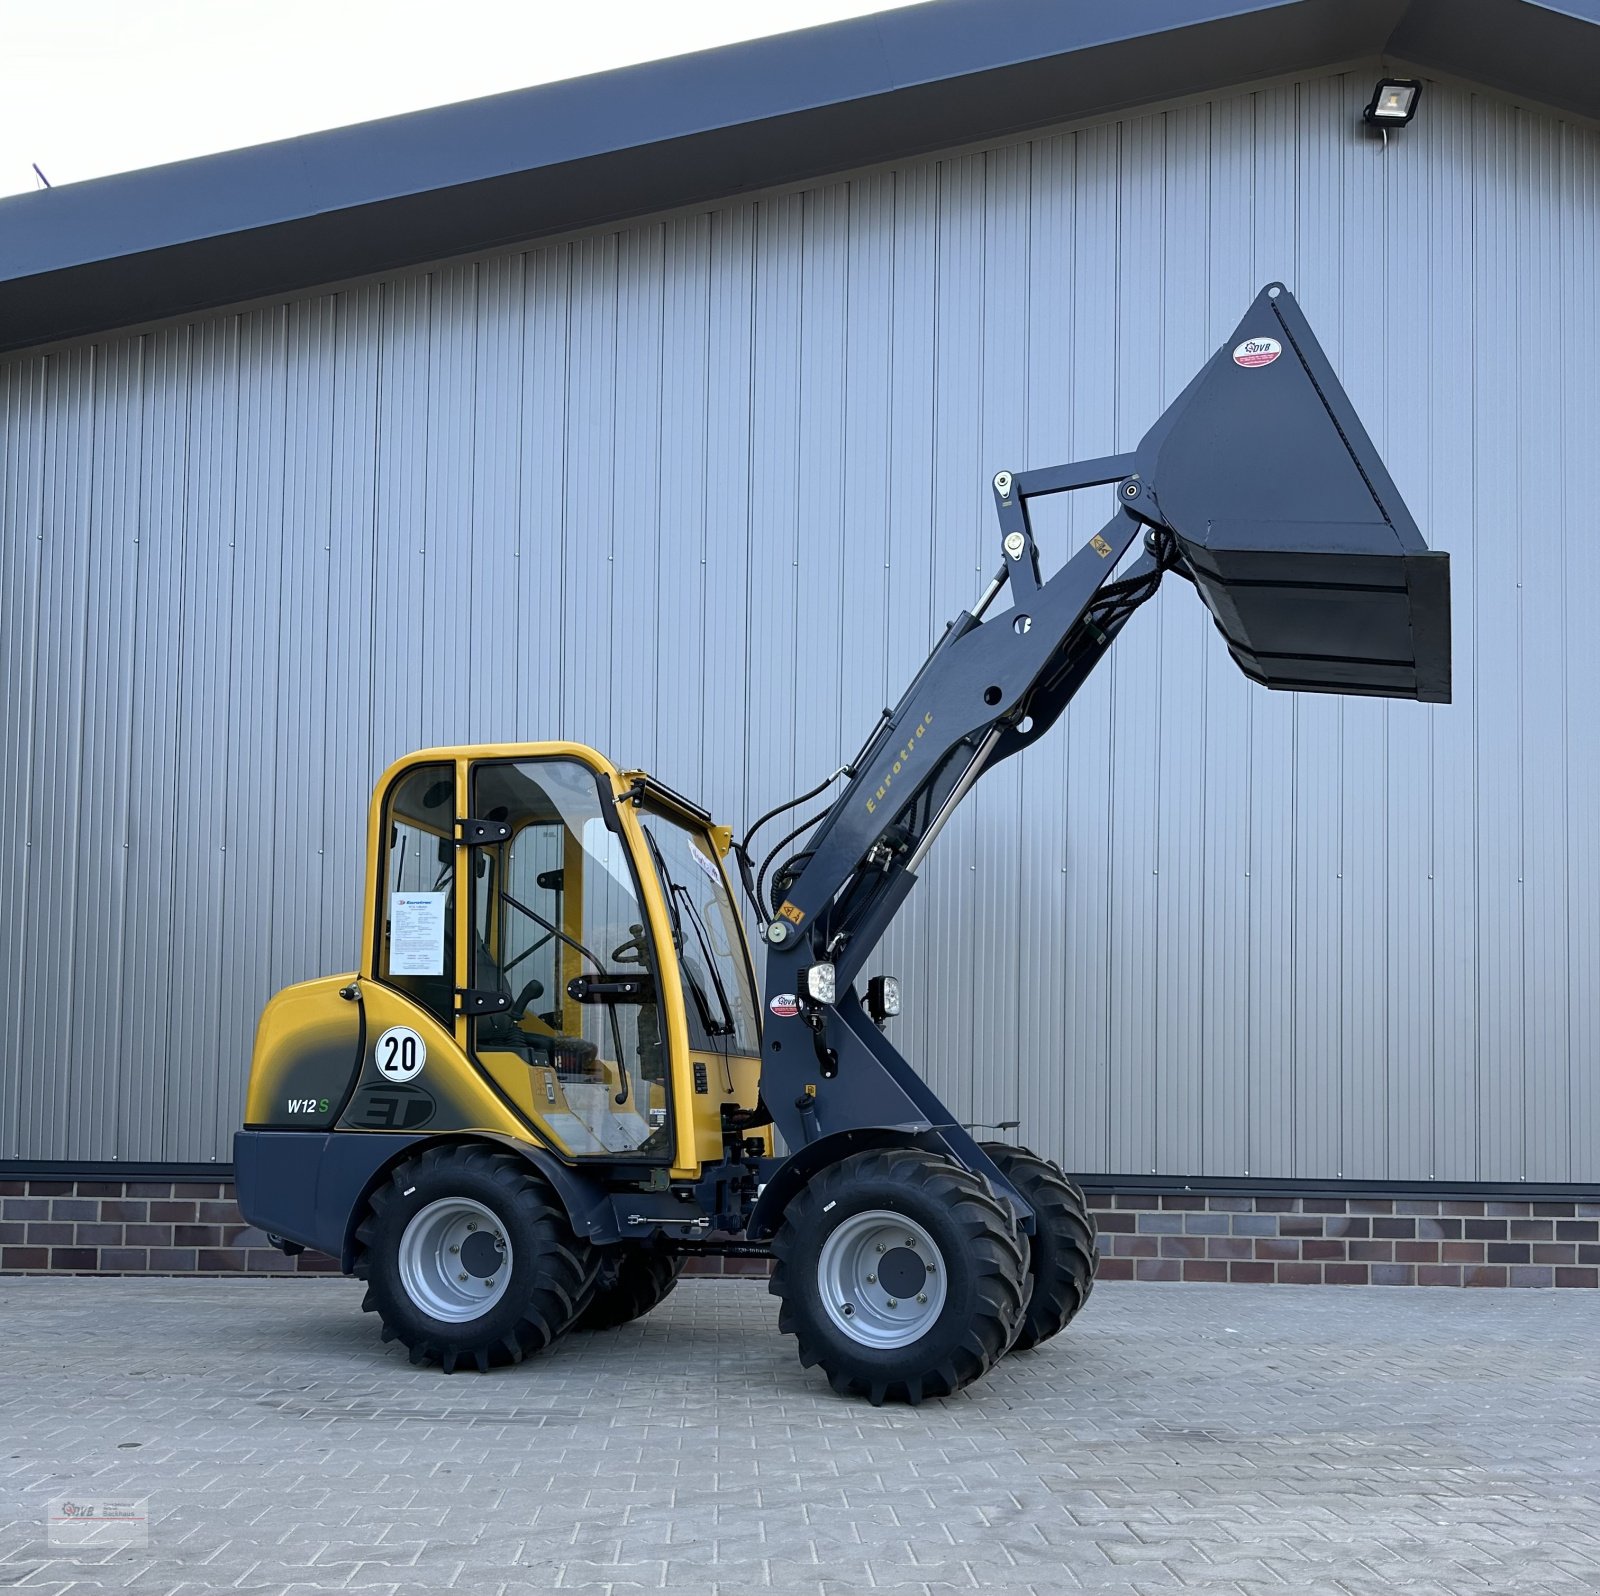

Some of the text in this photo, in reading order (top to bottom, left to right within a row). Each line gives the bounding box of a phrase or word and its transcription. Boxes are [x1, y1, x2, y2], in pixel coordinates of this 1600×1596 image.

[1254, 343, 1271, 353] DVB
[865, 711, 933, 814] Eurotrac
[384, 1036, 416, 1071] 20
[288, 1098, 329, 1114] W12 S
